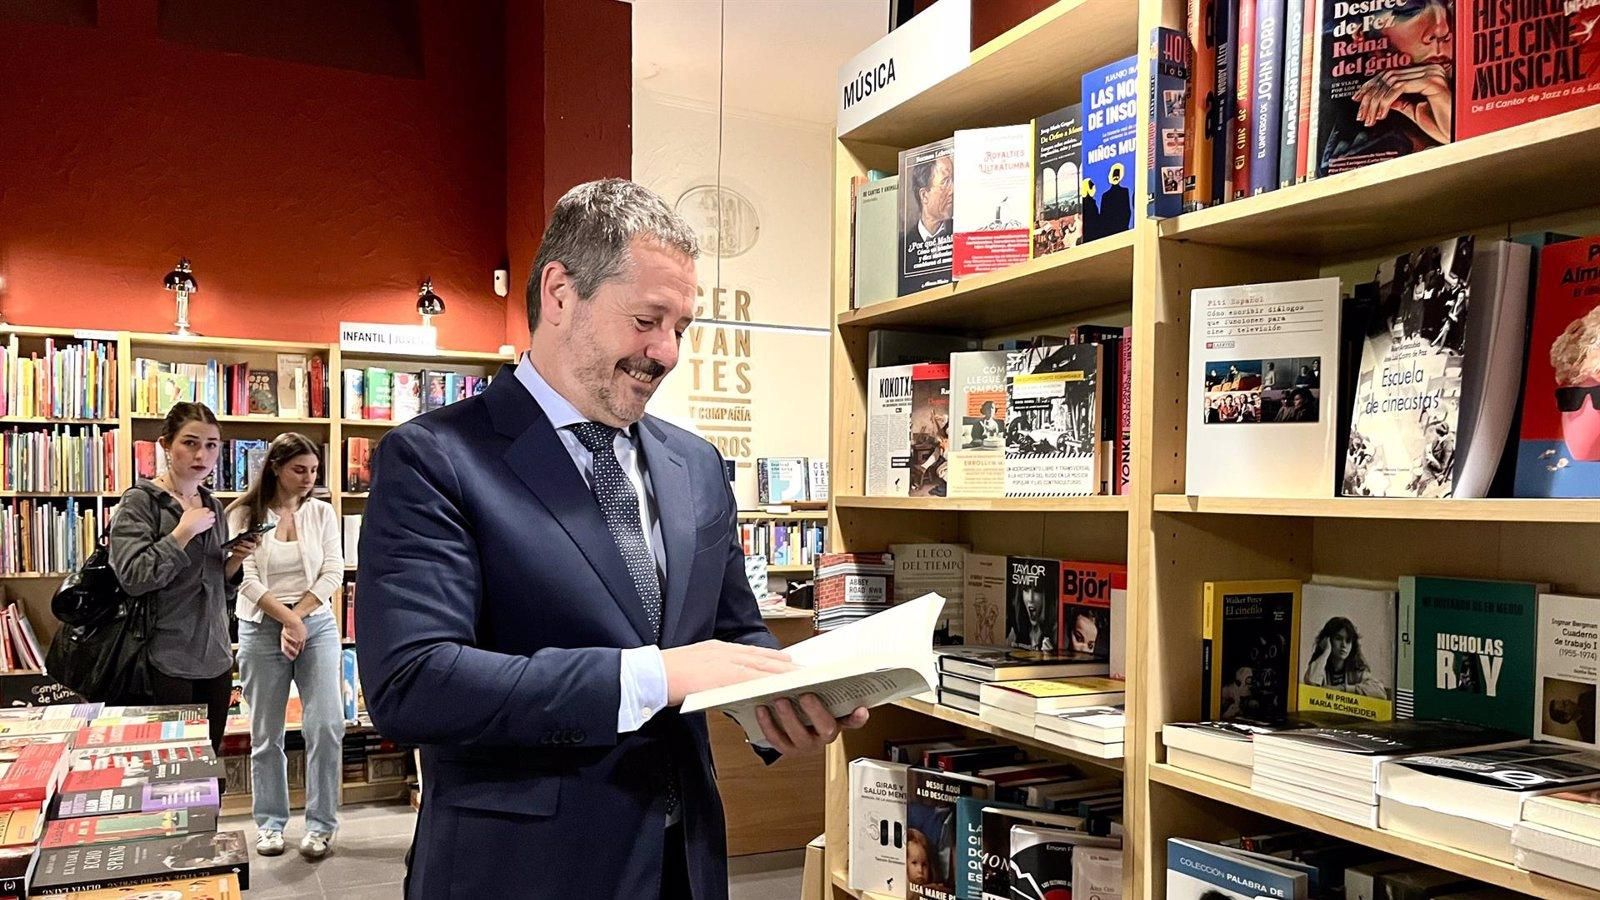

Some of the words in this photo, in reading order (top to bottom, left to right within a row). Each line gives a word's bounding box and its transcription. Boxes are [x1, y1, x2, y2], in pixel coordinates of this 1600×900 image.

[1473, 0, 1565, 32] HISTO
[1333, 20, 1359, 38] de
[1363, 12, 1395, 32] Fez
[1260, 16, 1275, 59] FORD
[1291, 11, 1302, 76] BRANDO
[1473, 26, 1514, 65] DEL
[1519, 13, 1578, 56] CINE
[1217, 42, 1228, 65] ALLEN
[1332, 36, 1388, 58] Reina
[1332, 57, 1361, 77] del
[1365, 53, 1411, 77] grito
[1472, 46, 1588, 100] MUSICAL
[843, 58, 896, 110] MÚSICA
[1105, 69, 1128, 85] JUANJO
[1216, 69, 1227, 95] WOODY
[1258, 60, 1272, 101] JOHN
[1091, 86, 1114, 110] LAS
[1472, 105, 1484, 113] De
[1496, 97, 1525, 109] Cantor
[1541, 91, 1561, 101] Jazz
[1237, 108, 1247, 122] de
[1259, 103, 1268, 113] DE
[1287, 76, 1299, 145] MARLON
[1088, 110, 1104, 132] DE
[1236, 127, 1247, 149] cine
[1258, 113, 1268, 152] UNIVERSO
[984, 150, 1024, 162] ROYALTIES
[1088, 143, 1117, 165] NIÑOS
[1235, 155, 1245, 170] El
[908, 242, 924, 252] ¿Por
[924, 238, 936, 249] qué
[1207, 299, 1226, 307] Piti
[1231, 296, 1264, 305] Español
[1207, 309, 1225, 317] Cómo
[1229, 307, 1264, 315] escribir
[1268, 304, 1304, 314] diálogos
[1225, 317, 1264, 325] funcionen
[1238, 325, 1281, 333] televisión
[343, 331, 386, 343] INFANTIL
[689, 326, 751, 358] VAN
[689, 358, 752, 394] TES
[967, 374, 999, 384] LLEGUÉ
[1382, 360, 1424, 388] Escuela
[1365, 394, 1379, 415] de
[1382, 389, 1440, 413] cineastas
[699, 406, 752, 422] COMPAÑÍA
[930, 549, 952, 558] ECO
[902, 561, 923, 570] DEL
[924, 561, 964, 570] TIEMPO
[1012, 563, 1046, 576] TAYLOR
[1012, 574, 1039, 586] SWIFT
[1225, 606, 1233, 615] El
[1235, 605, 1263, 615] cinéfilo
[1551, 618, 1571, 626] Ingmar
[1572, 620, 1598, 629] Bergman
[1562, 628, 1598, 639] Cuaderno
[1437, 632, 1504, 656] NICHOLAS
[1564, 639, 1591, 650] trabajo
[1559, 648, 1597, 661] (1955-1974)
[1437, 649, 1503, 697] RAY
[38, 694, 51, 703] de
[1325, 692, 1334, 701] MI
[1335, 694, 1359, 705] PRIMA
[1309, 698, 1332, 710] MARIA
[1334, 702, 1377, 718] SCHNEIDER
[863, 787, 887, 796] SALUD
[875, 781, 897, 790] GIRAS
[922, 788, 929, 797] LO
[926, 780, 944, 791] DESDE
[83, 850, 103, 870] ECHO
[107, 845, 126, 871] SPRING
[1180, 857, 1224, 878] COLECCIÓN
[1226, 873, 1267, 892] PALABRA
[1270, 887, 1284, 897] DE
[42, 887, 70, 895] LAING
[71, 884, 101, 892] OLIVIA
[910, 882, 924, 894] LISA
[925, 888, 946, 900] MARIE
